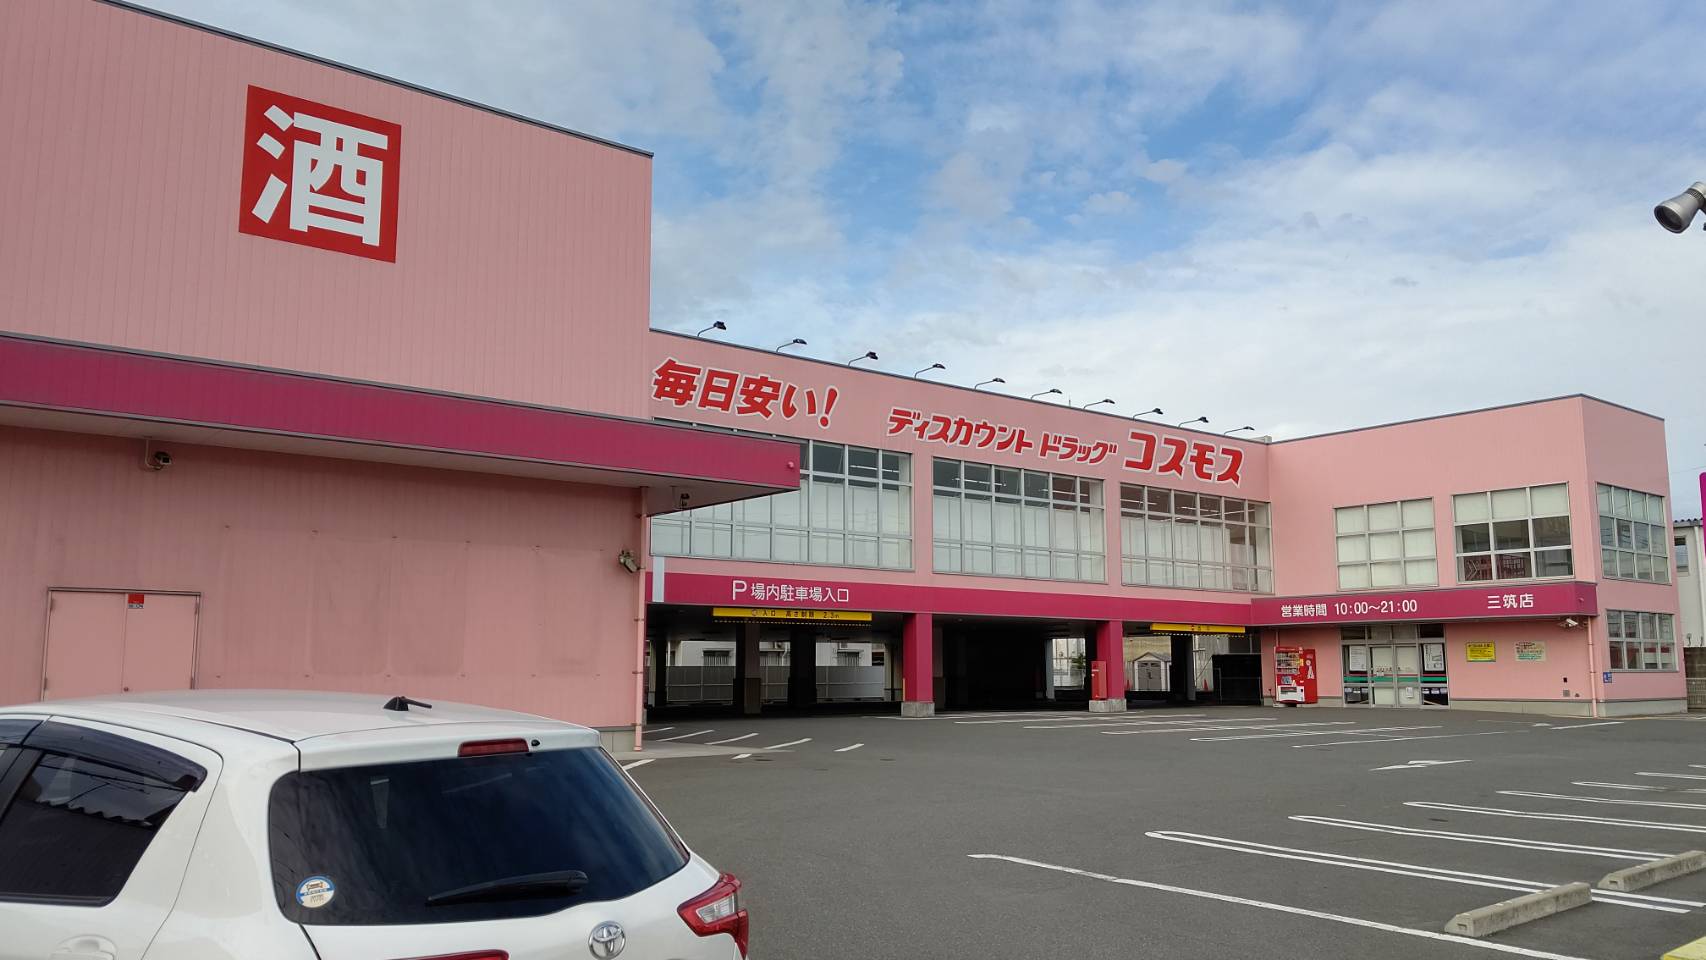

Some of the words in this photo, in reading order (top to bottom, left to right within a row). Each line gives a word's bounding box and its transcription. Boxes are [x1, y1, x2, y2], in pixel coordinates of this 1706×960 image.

[251, 104, 388, 247] 酒
[652, 357, 838, 429] 毎日安い!
[887, 407, 1034, 455] ディスカウント
[1038, 432, 1119, 465] ドラッグ
[1123, 429, 1245, 487] コスモス
[732, 580, 748, 600] P
[751, 583, 849, 602] 場内駐車場入口
[1281, 604, 1327, 617] 営業時間
[1487, 593, 1535, 609] 三筑店
